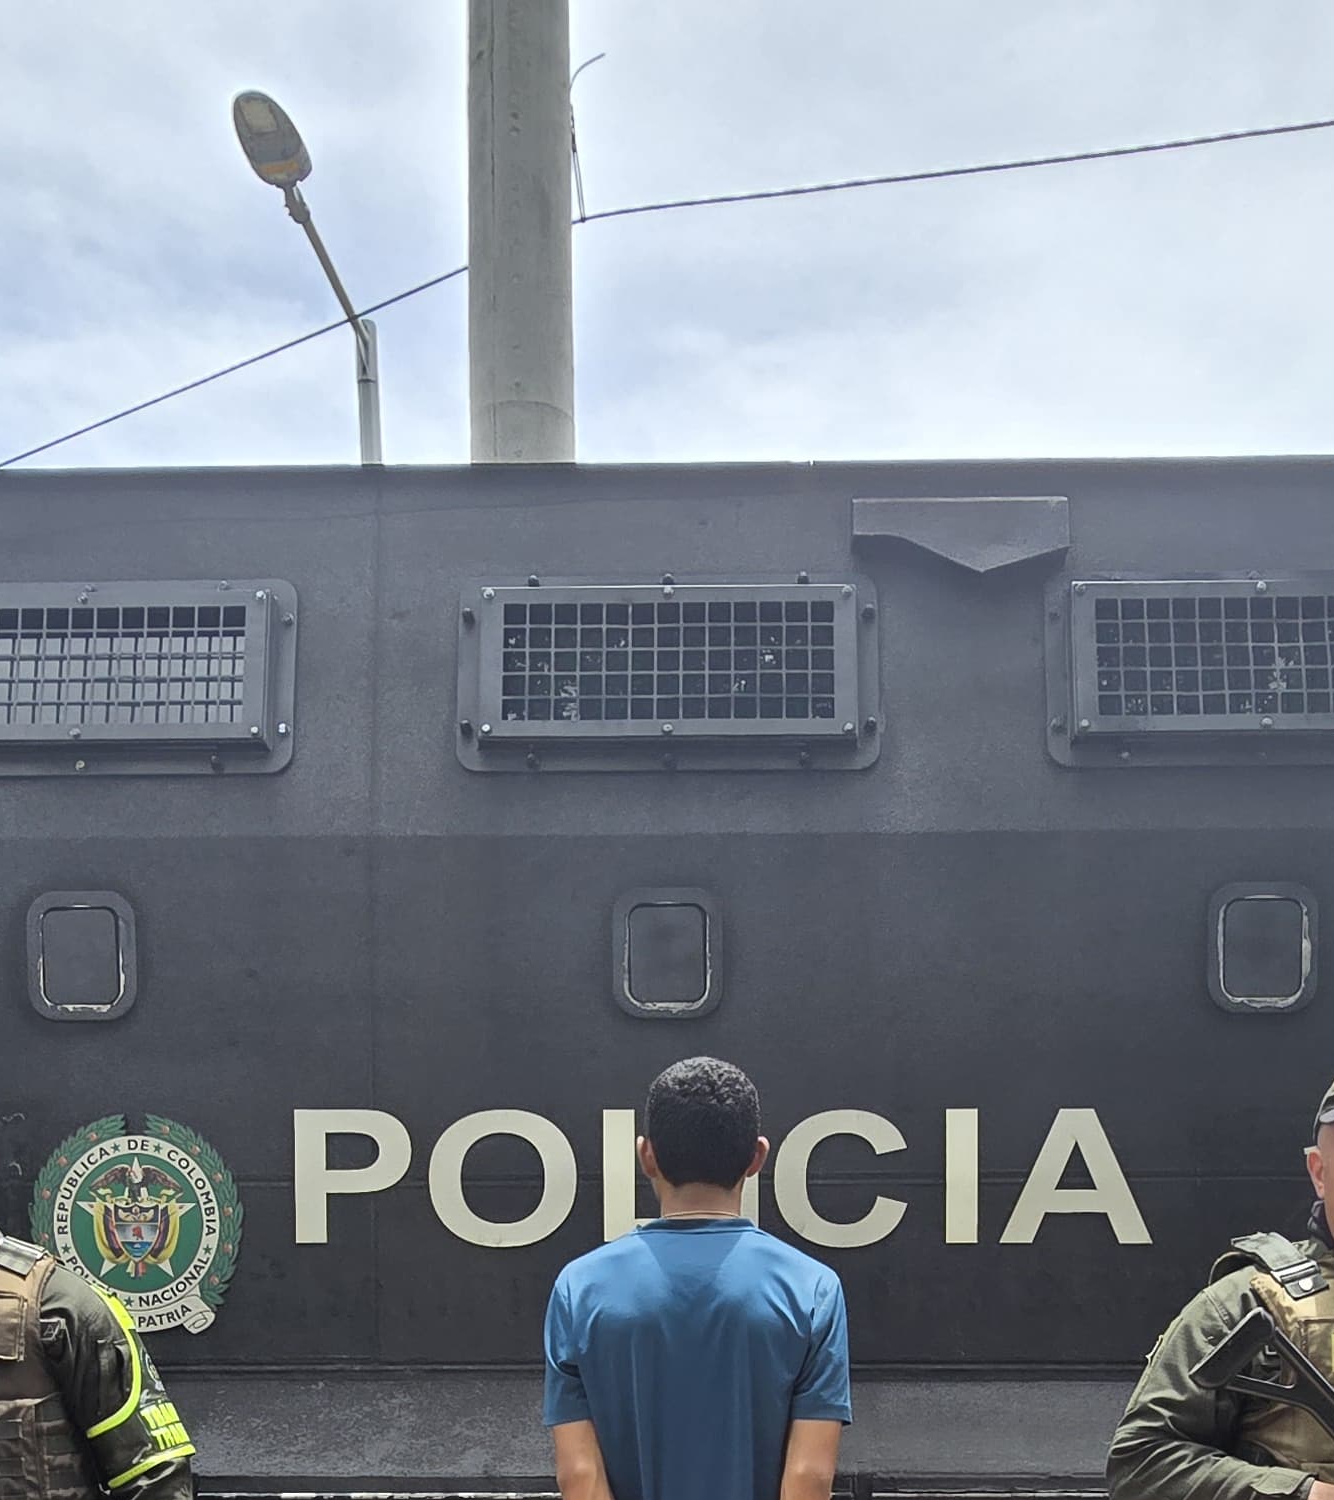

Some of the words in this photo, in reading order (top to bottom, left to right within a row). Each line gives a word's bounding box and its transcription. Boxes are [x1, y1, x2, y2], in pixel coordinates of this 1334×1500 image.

[127, 1138, 150, 1152] DE
[167, 1149, 217, 1236] COLOMBIA
[293, 1107, 1153, 1248] POLCIA
[138, 1256, 212, 1308] NACIONAL
[138, 1303, 192, 1328] PATRIA
